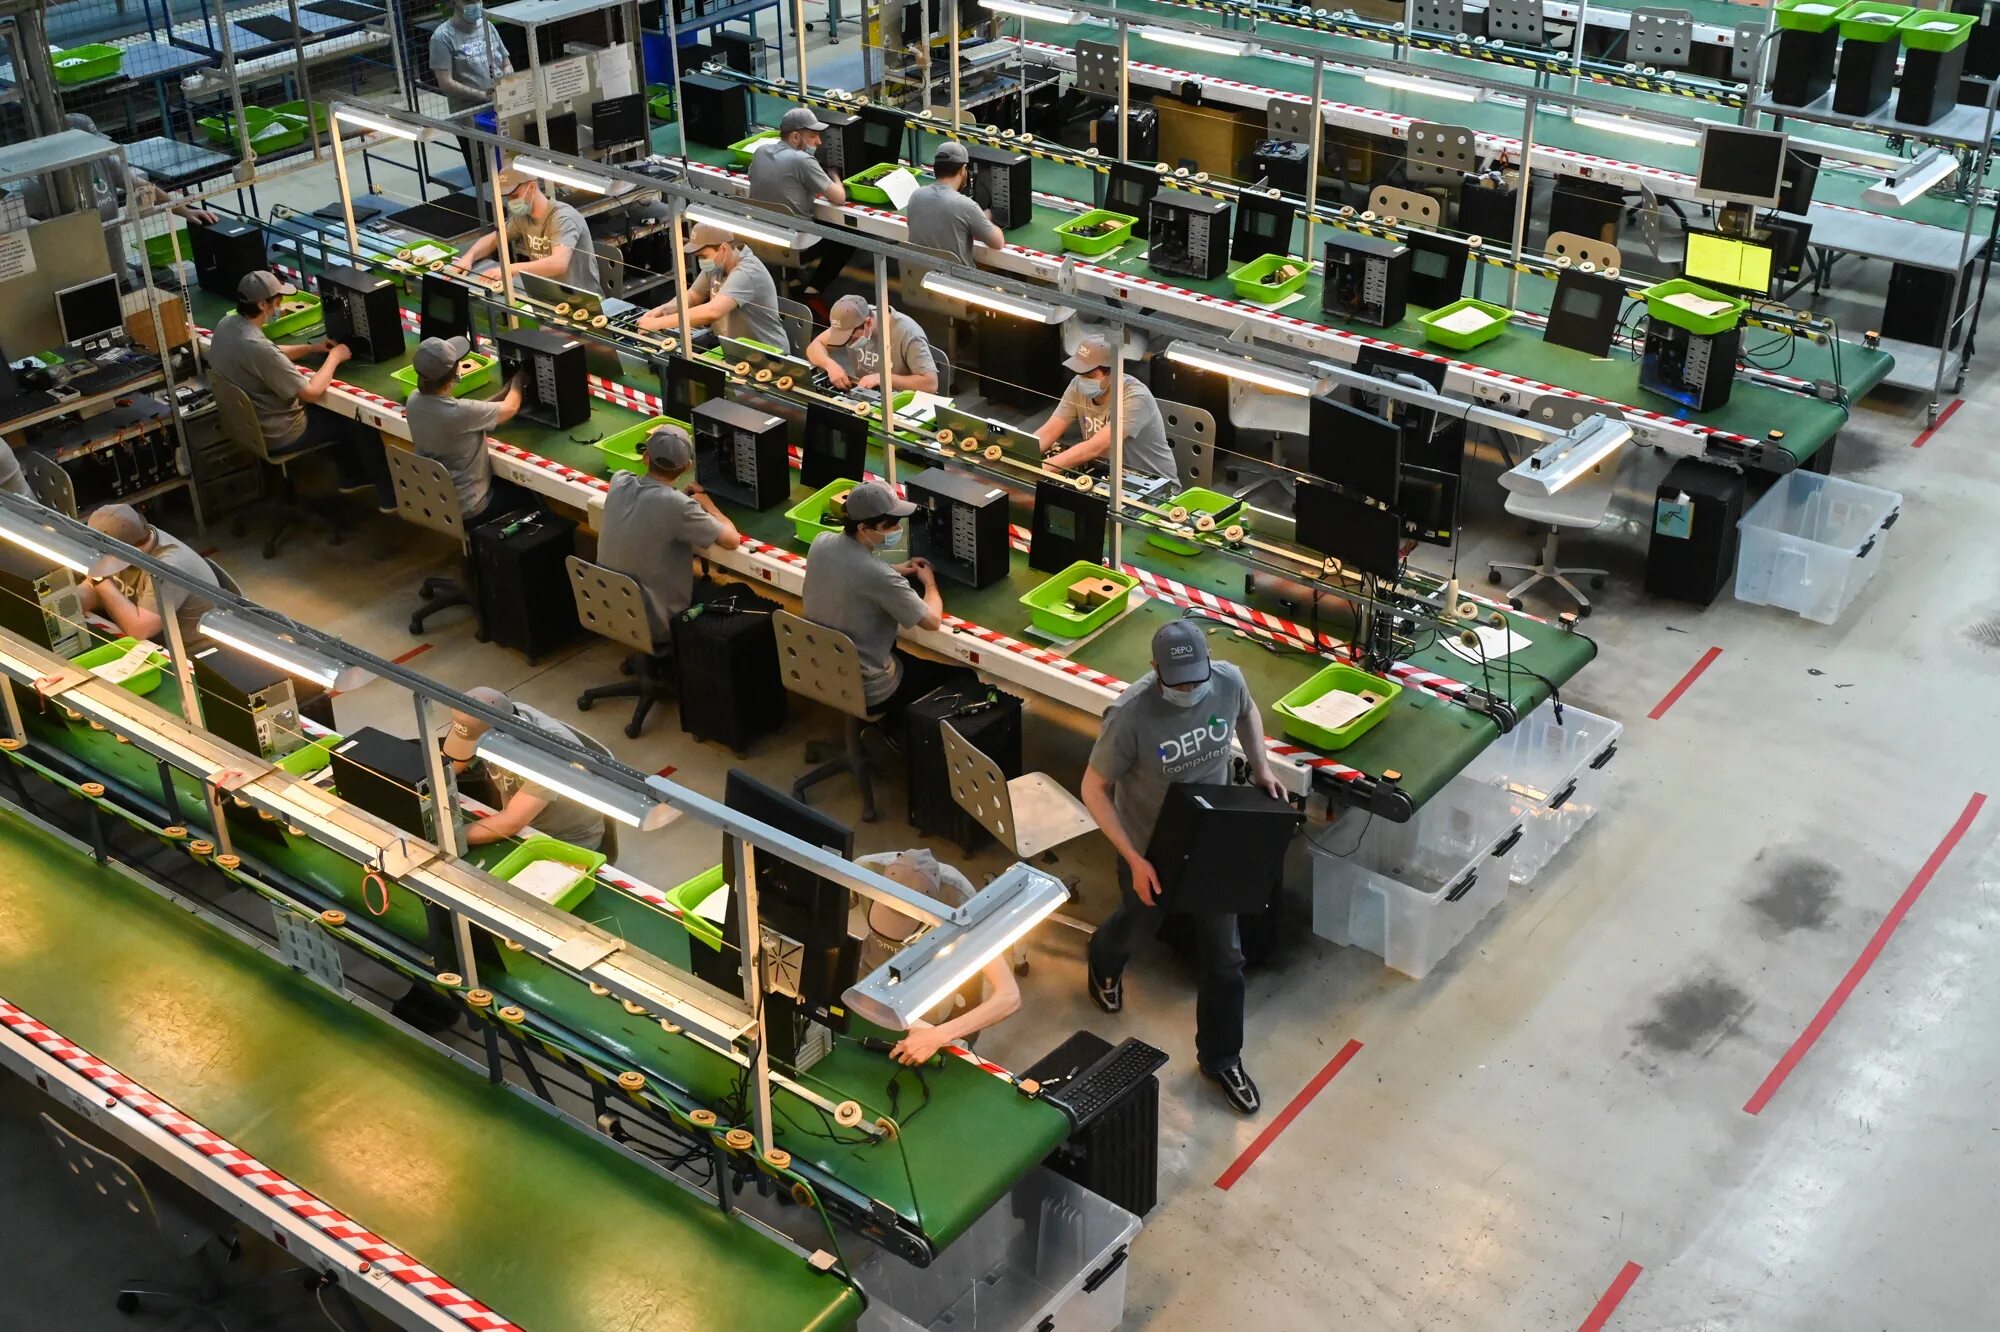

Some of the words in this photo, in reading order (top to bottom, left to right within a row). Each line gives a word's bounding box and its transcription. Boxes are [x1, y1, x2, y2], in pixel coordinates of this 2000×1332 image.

[856, 348, 880, 367] DEP
[1170, 644, 1193, 655] DEPO
[1159, 716, 1229, 763] DEPO
